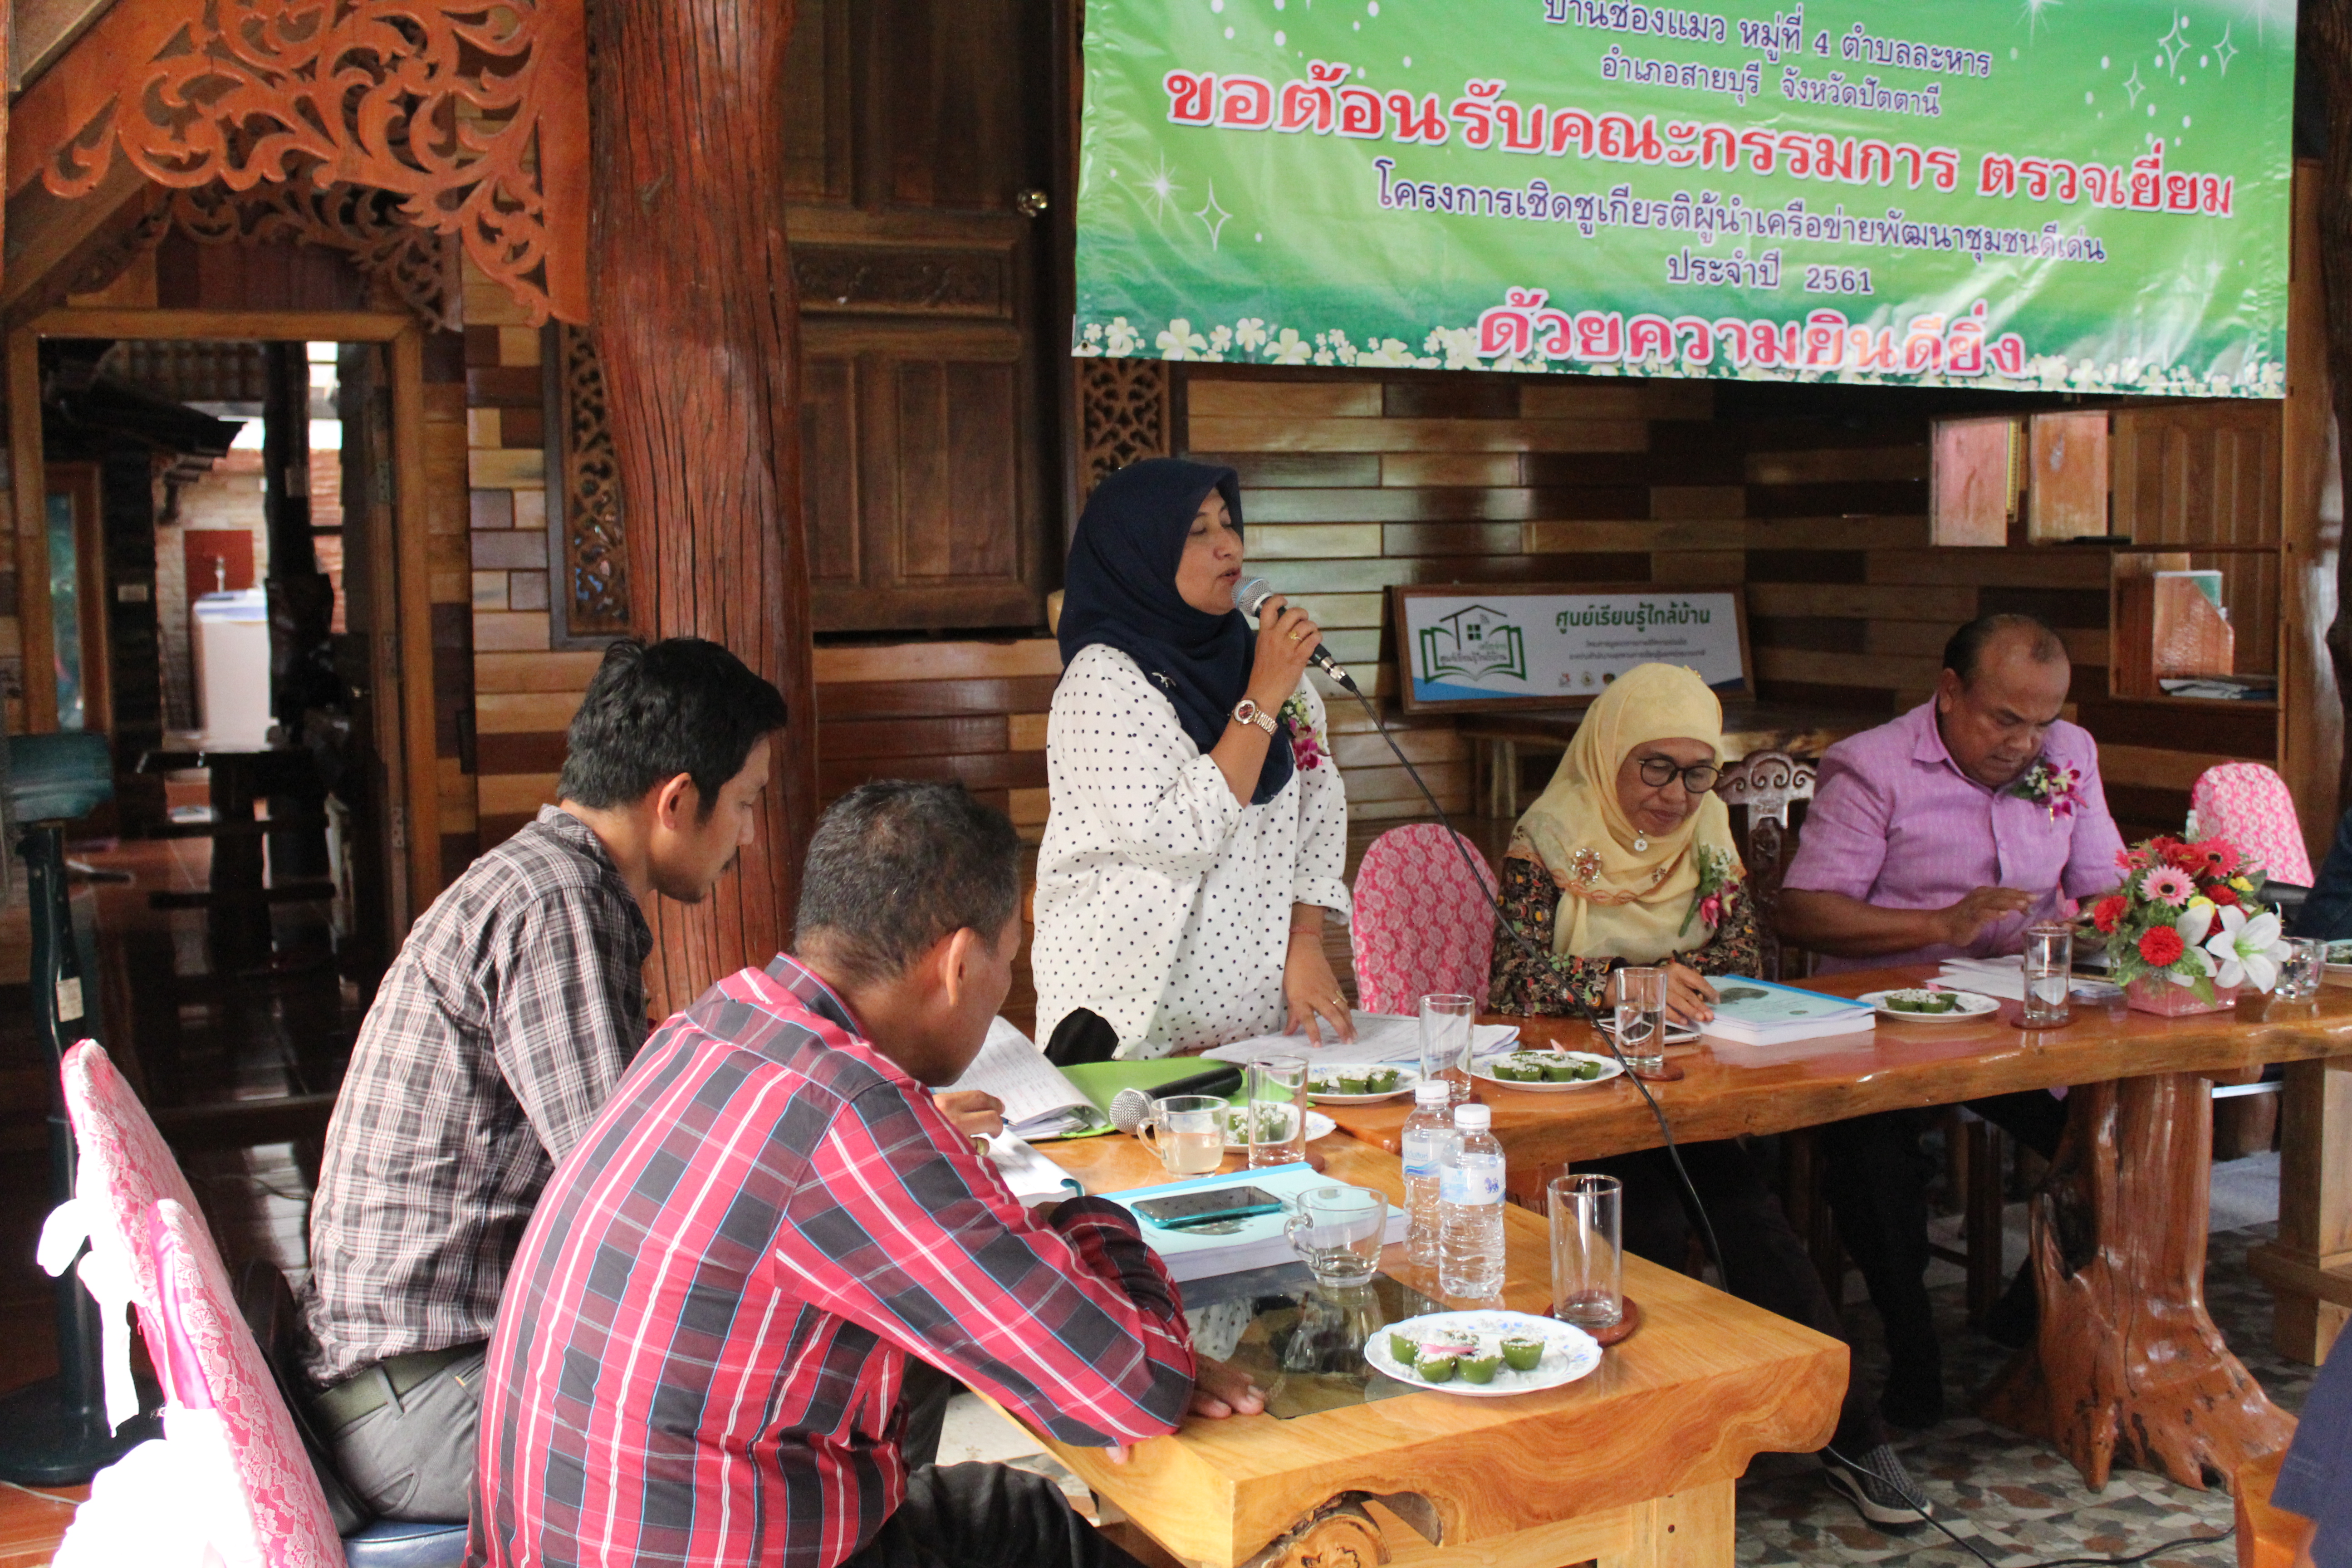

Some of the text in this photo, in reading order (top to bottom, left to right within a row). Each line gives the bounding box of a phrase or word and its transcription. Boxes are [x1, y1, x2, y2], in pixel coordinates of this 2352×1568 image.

[1740, 5, 1803, 62] หมู่ที่
[1814, 31, 1830, 55] 4
[1842, 24, 1992, 76] ตำบลละหาร
[1602, 46, 1941, 115] อำเภอสายบุรี จังหวัดปัตตานี
[1166, 62, 2234, 216] ขอต้อนรับคณะกรรมการ ตรวจเยี่ยม
[1374, 159, 2105, 262] โครงการเชิดชูเกียรติผู้นำเครือข่ายพัฒนาชุมชนดีเด่น
[1667, 248, 1873, 293] ประจำปี 2561
[1479, 289, 2023, 375] ด้วยความยินดียิ่ง
